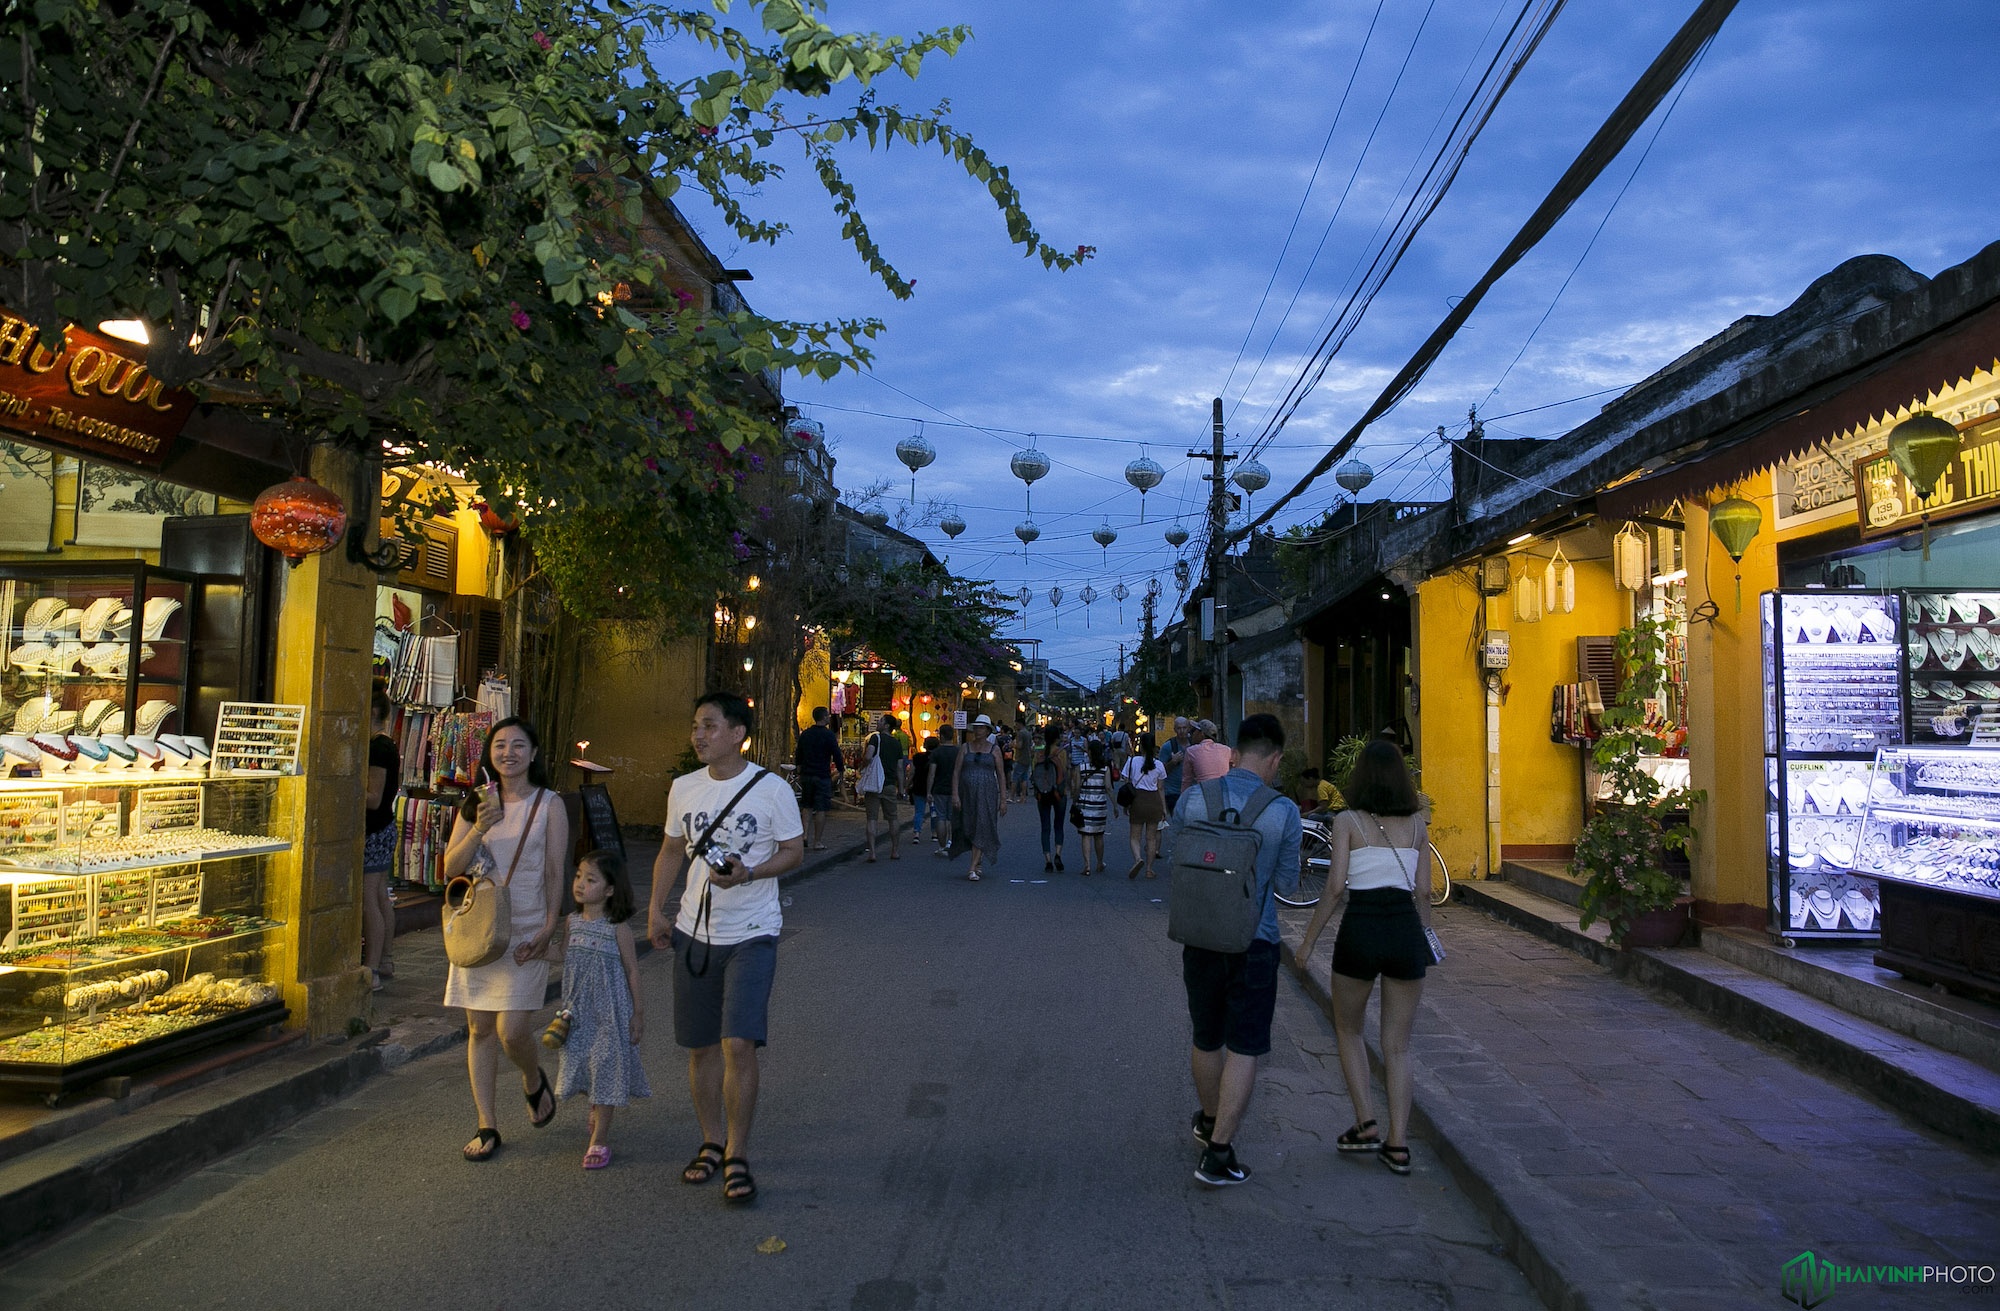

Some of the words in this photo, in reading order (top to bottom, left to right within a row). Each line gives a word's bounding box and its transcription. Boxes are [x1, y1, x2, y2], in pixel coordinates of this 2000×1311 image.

[1876, 502, 1893, 515] 139
[1789, 763, 1824, 771] CUFFLINK
[1866, 763, 1887, 771] MEY
